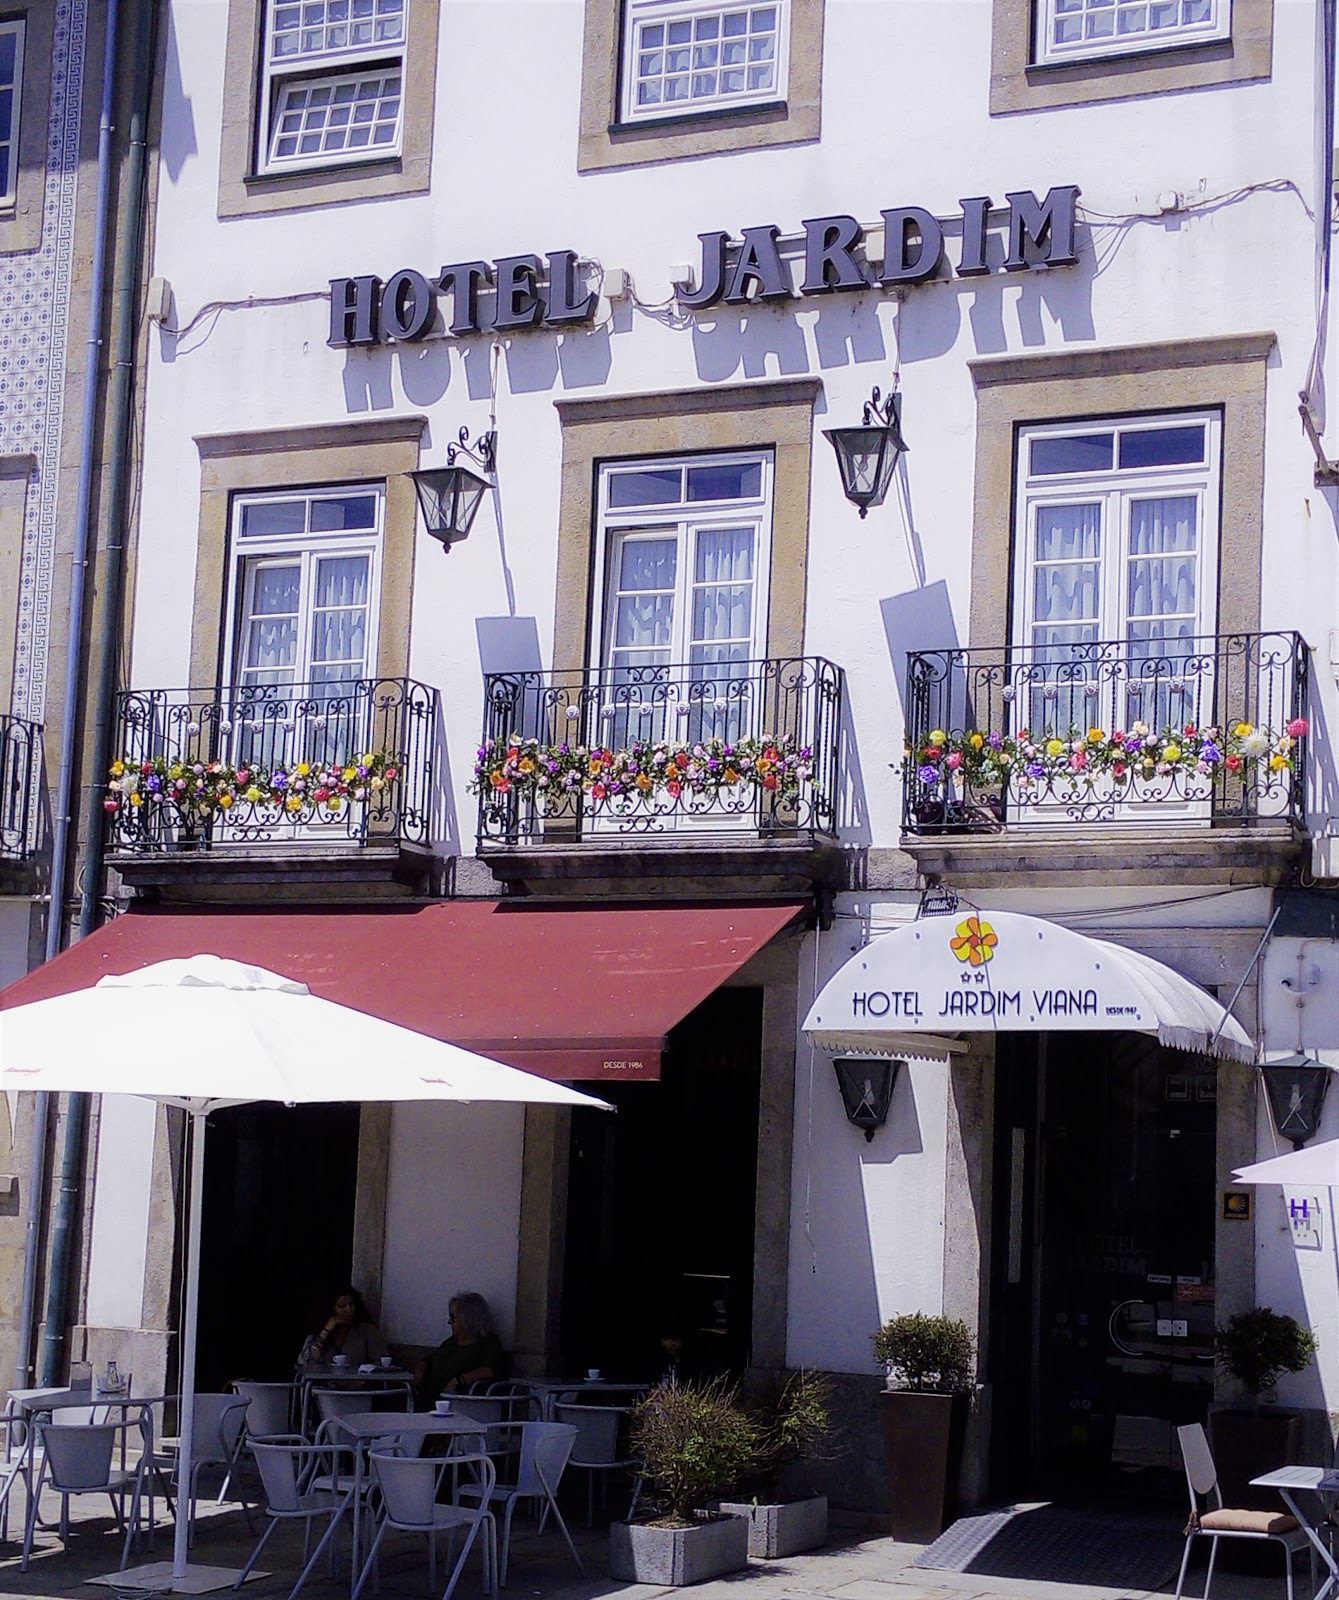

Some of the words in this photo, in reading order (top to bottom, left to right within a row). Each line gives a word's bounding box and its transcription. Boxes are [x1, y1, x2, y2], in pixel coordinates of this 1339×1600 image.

[326, 249, 600, 350] HOTEL
[680, 184, 1083, 307] JARDIM
[852, 990, 924, 1018] HOTEL
[938, 990, 1021, 1018] JARDIM
[1032, 989, 1098, 1017] VIANA
[603, 1061, 627, 1069] DESDE
[628, 1061, 644, 1069] 1986
